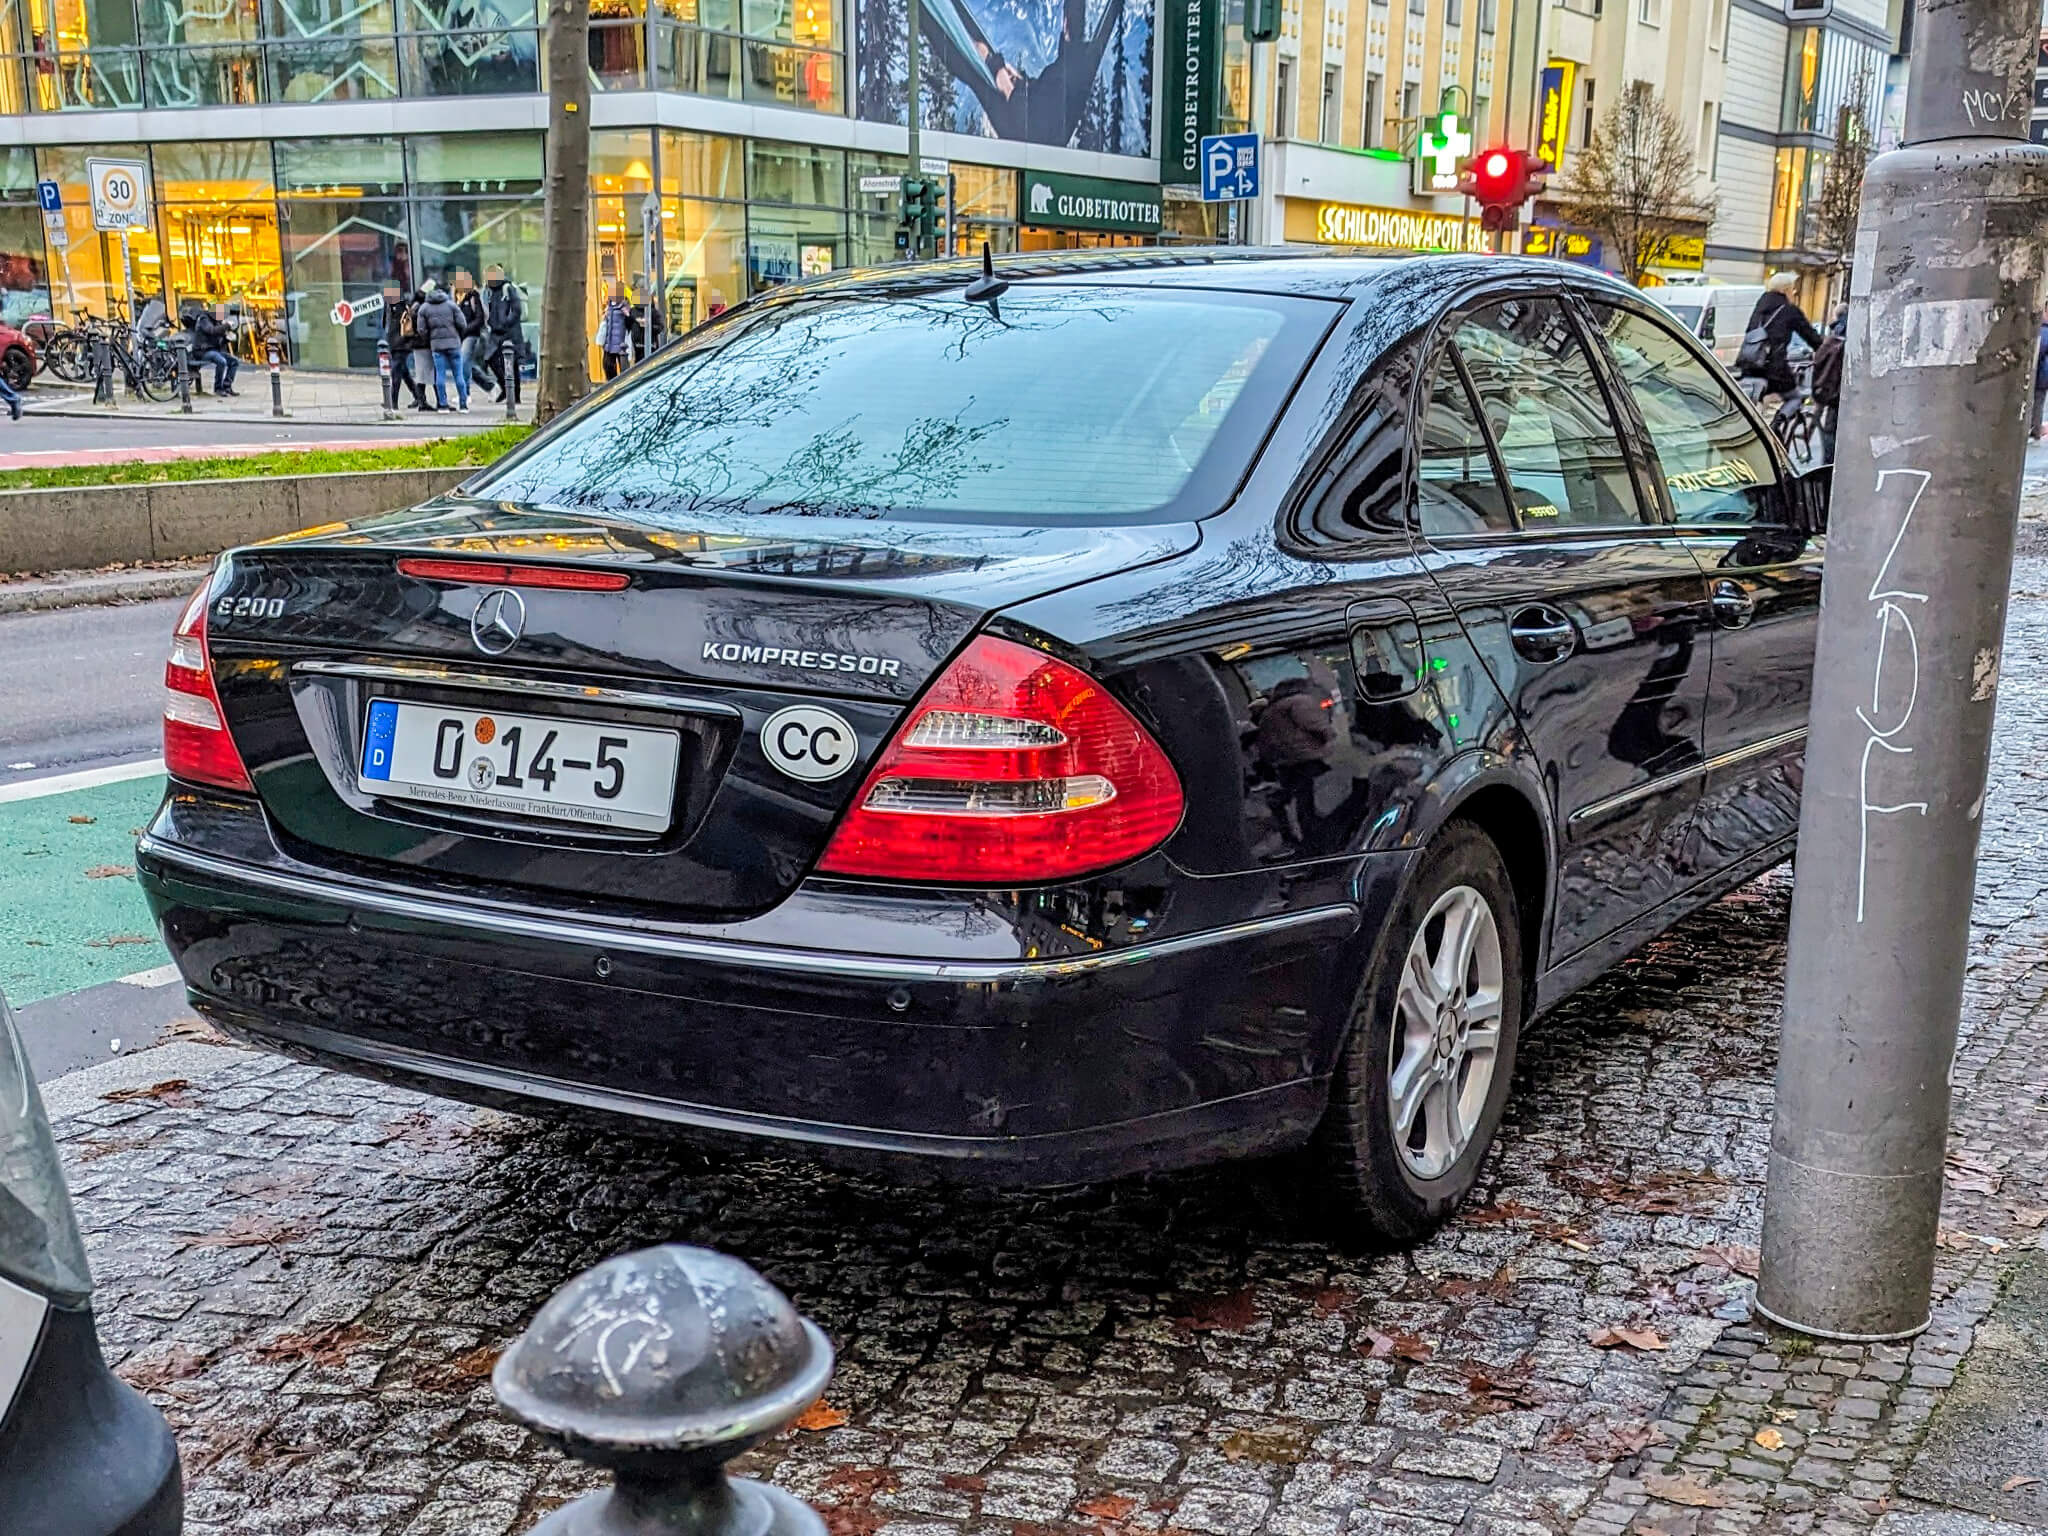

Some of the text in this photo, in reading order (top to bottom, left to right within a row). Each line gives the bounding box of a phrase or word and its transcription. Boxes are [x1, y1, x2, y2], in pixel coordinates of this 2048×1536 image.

[1183, 1, 1201, 171] GLOBETROTTER
[108, 180, 131, 200] 30
[108, 213, 135, 225] ZON
[1057, 195, 1160, 224] GLOBETROTTER
[352, 297, 381, 313] WINTER
[216, 596, 286, 619] E200
[702, 641, 901, 678] KOMPRESSOR
[372, 748, 385, 766] D
[776, 721, 842, 766] CC
[432, 718, 628, 800] 0 14-5
[408, 785, 614, 824] Mercedes-Benz Niederlassung Frankfurt/Offenbach
